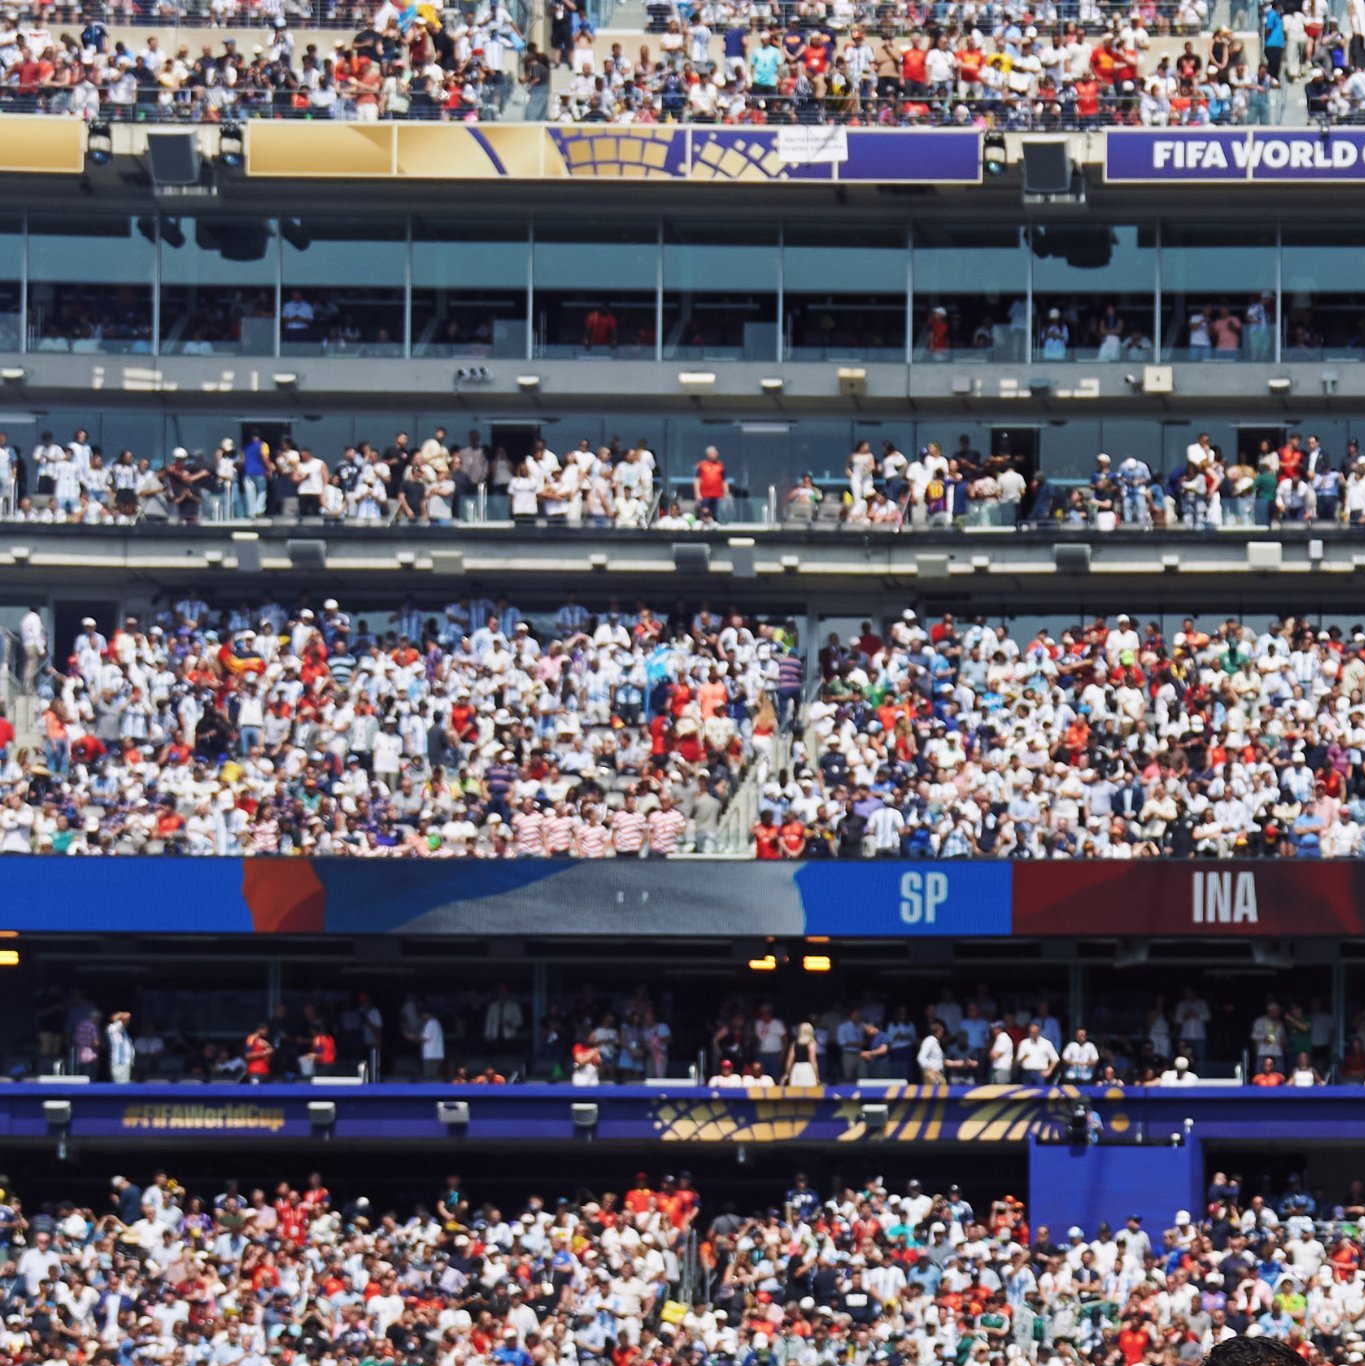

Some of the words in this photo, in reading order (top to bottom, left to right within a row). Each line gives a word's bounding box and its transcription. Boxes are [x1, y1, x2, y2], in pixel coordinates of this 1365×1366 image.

[1153, 140, 1228, 168] FIFA
[1232, 140, 1358, 168] WORLD
[901, 871, 949, 924] SP
[1192, 871, 1259, 923] INA
[123, 1104, 285, 1131] #FIFAWorldCup
